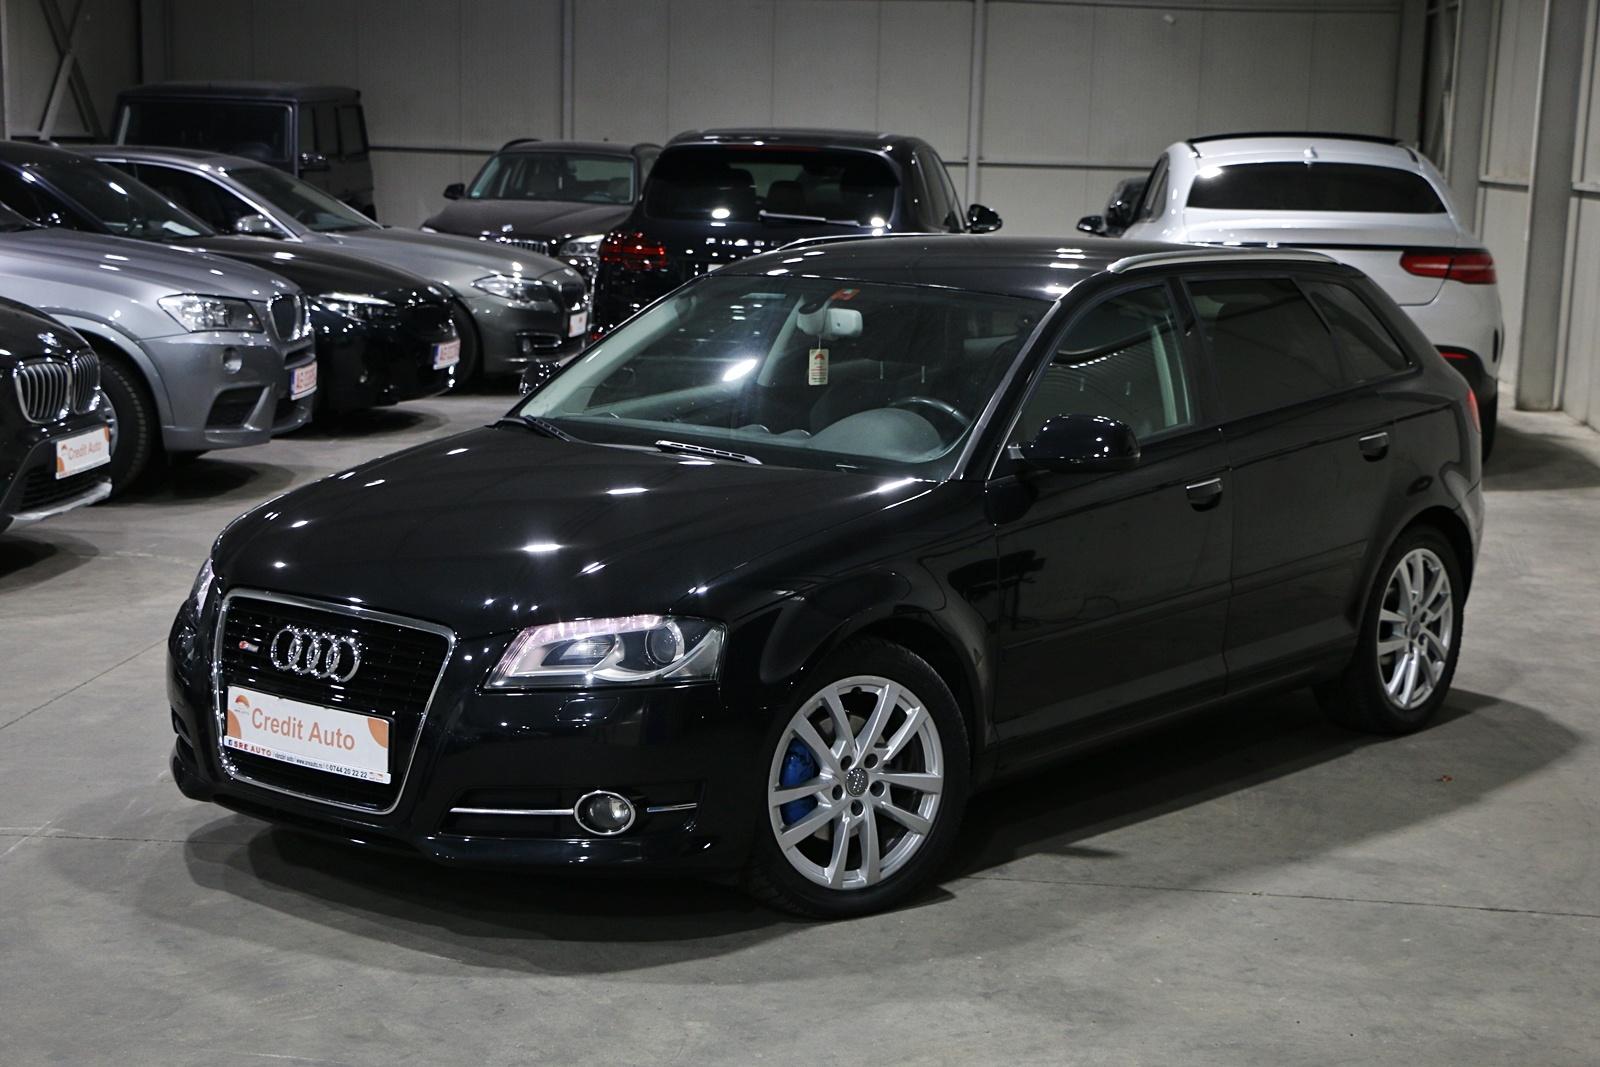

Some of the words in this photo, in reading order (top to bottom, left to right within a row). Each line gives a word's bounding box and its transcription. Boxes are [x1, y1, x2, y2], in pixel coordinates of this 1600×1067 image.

[252, 707, 303, 741] Credit
[308, 722, 355, 750] Auto
[250, 745, 272, 757] AUTO
[351, 769, 359, 777] 22
[360, 771, 368, 779] 22
